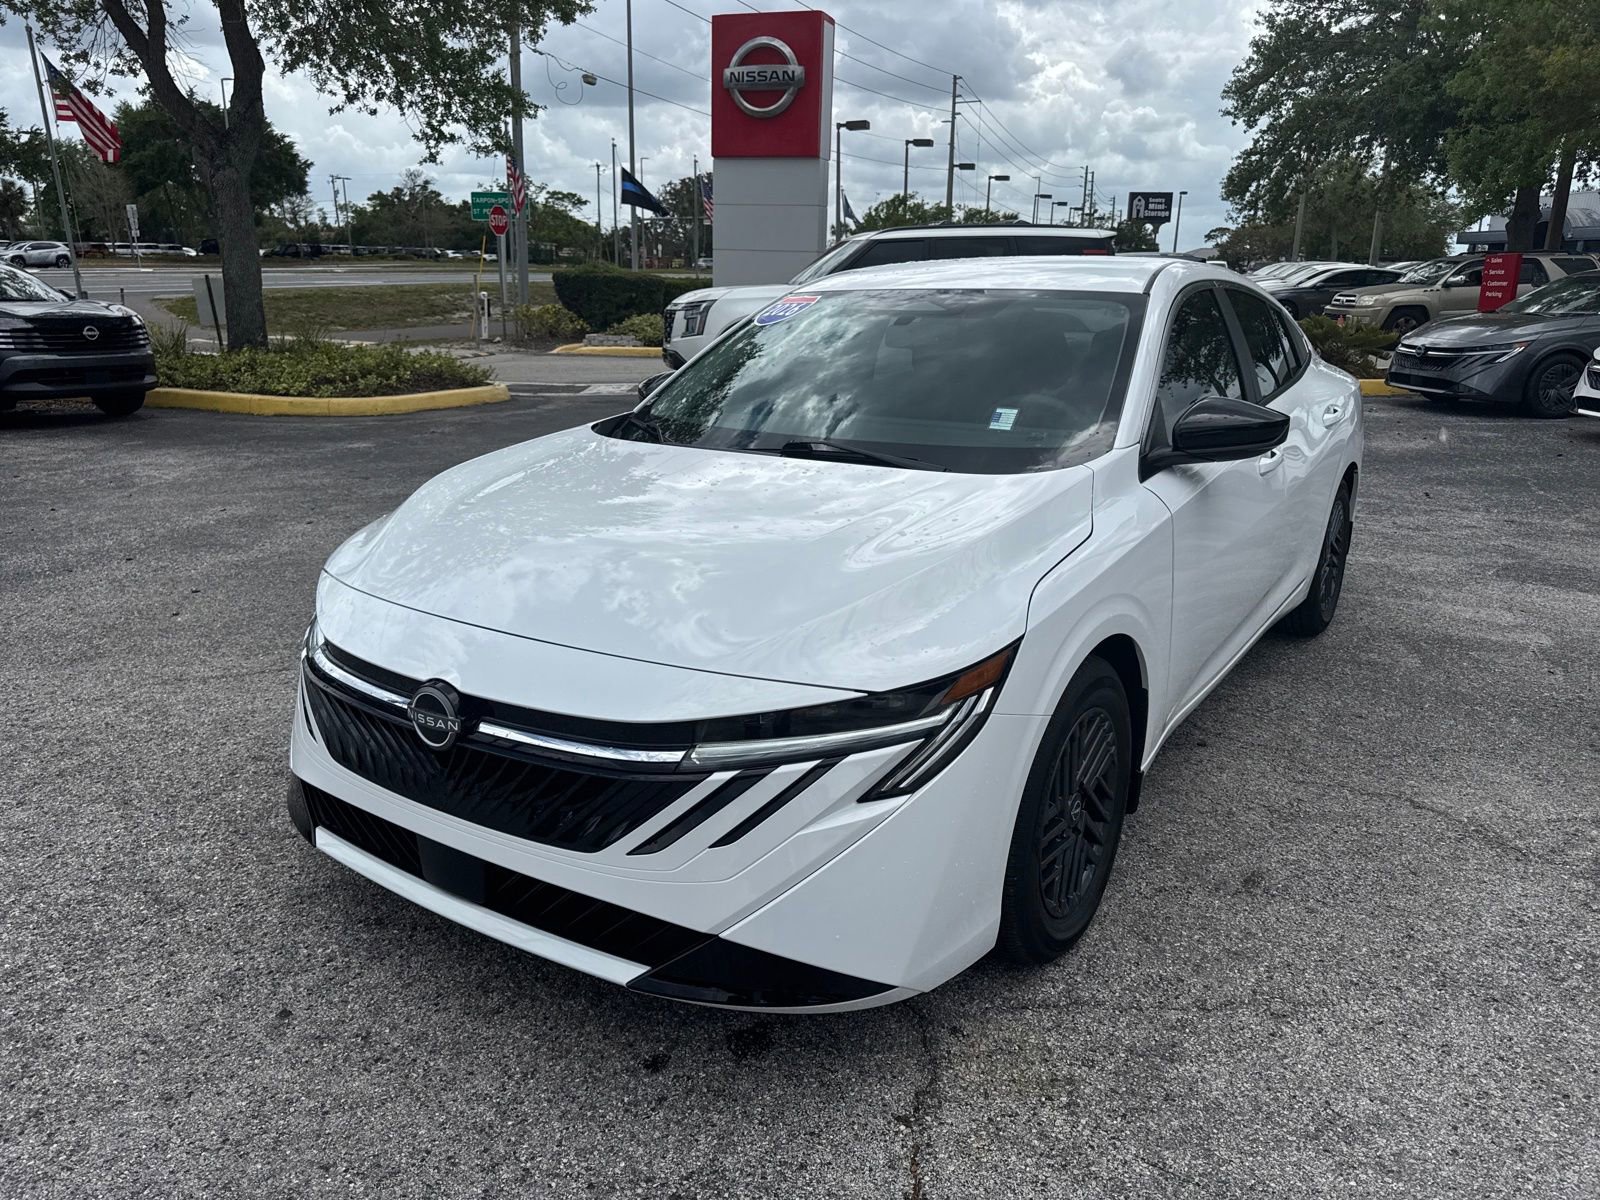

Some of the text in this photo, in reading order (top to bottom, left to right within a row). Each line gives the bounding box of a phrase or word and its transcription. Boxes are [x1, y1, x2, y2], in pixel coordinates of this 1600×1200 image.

[729, 70, 796, 83] NISSAN
[490, 214, 507, 226] STOP
[1143, 210, 1170, 218] Storage
[1485, 291, 1503, 299] Parking
[407, 707, 458, 731] NISSAN
